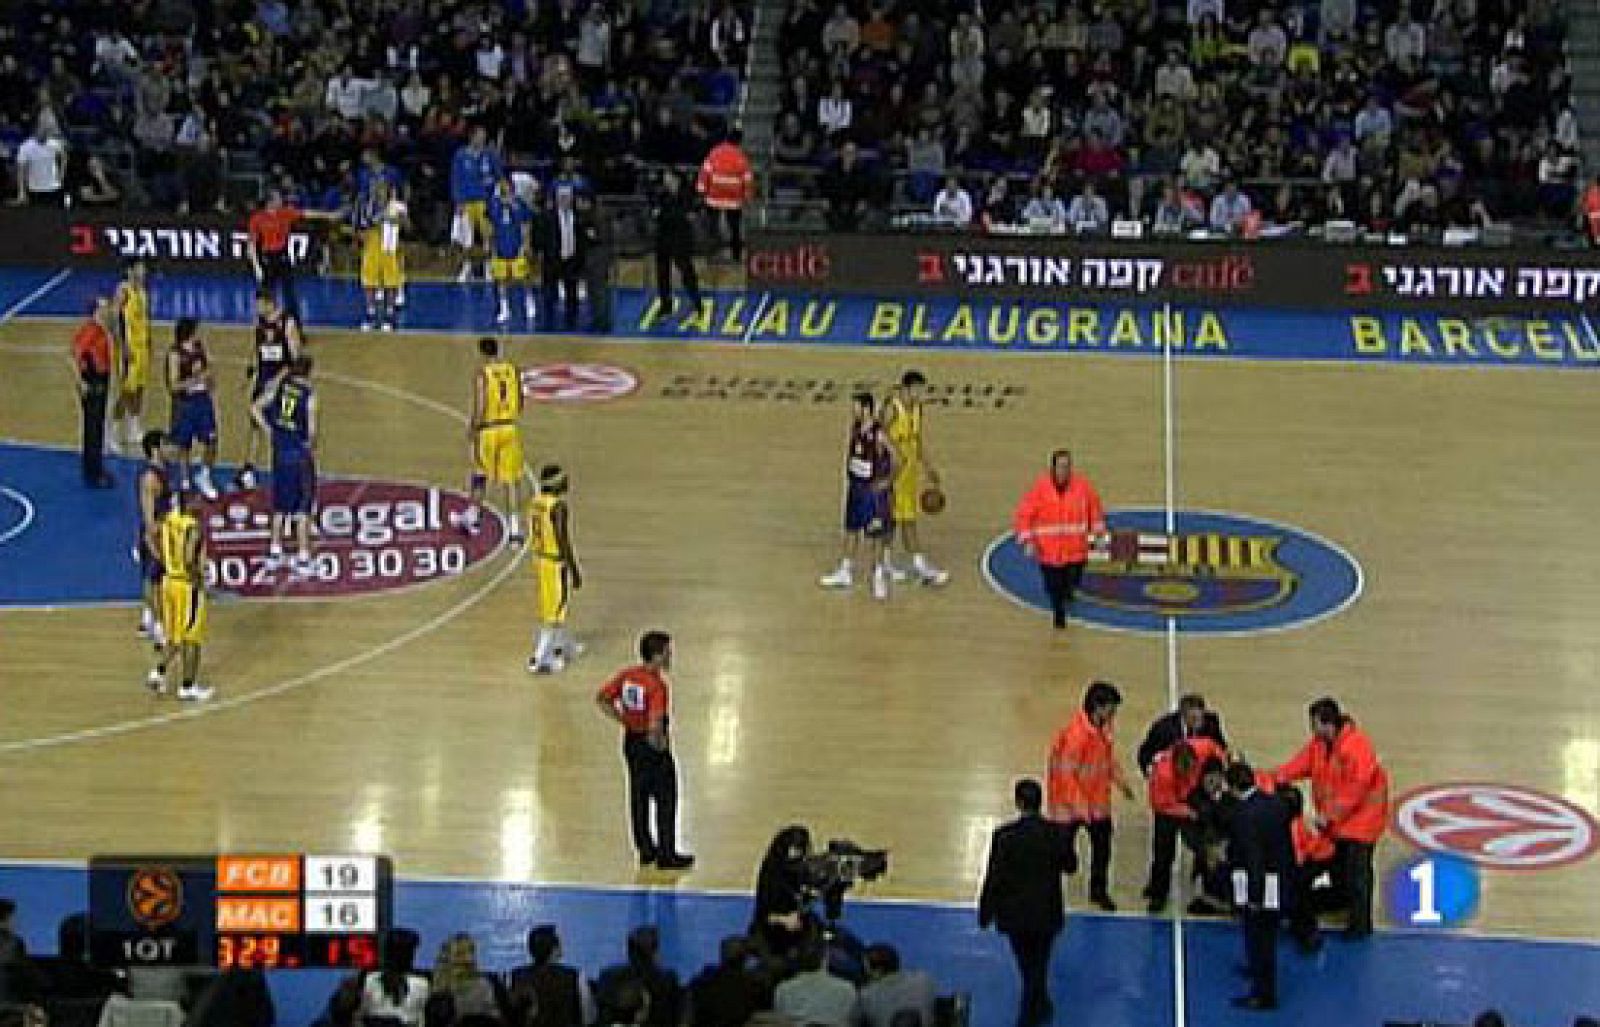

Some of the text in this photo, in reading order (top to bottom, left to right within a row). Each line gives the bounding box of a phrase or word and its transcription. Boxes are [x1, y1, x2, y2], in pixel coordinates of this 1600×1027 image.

[104, 227, 219, 257] אורגני
[231, 231, 309, 267] קה
[953, 254, 1071, 285] אורגני
[1081, 257, 1163, 293] קפה
[1381, 266, 1504, 296] אורגני
[1516, 267, 1600, 303] קפה
[869, 302, 1229, 350] BLAUGRANA
[351, 549, 403, 578] 30
[412, 544, 465, 576] 30
